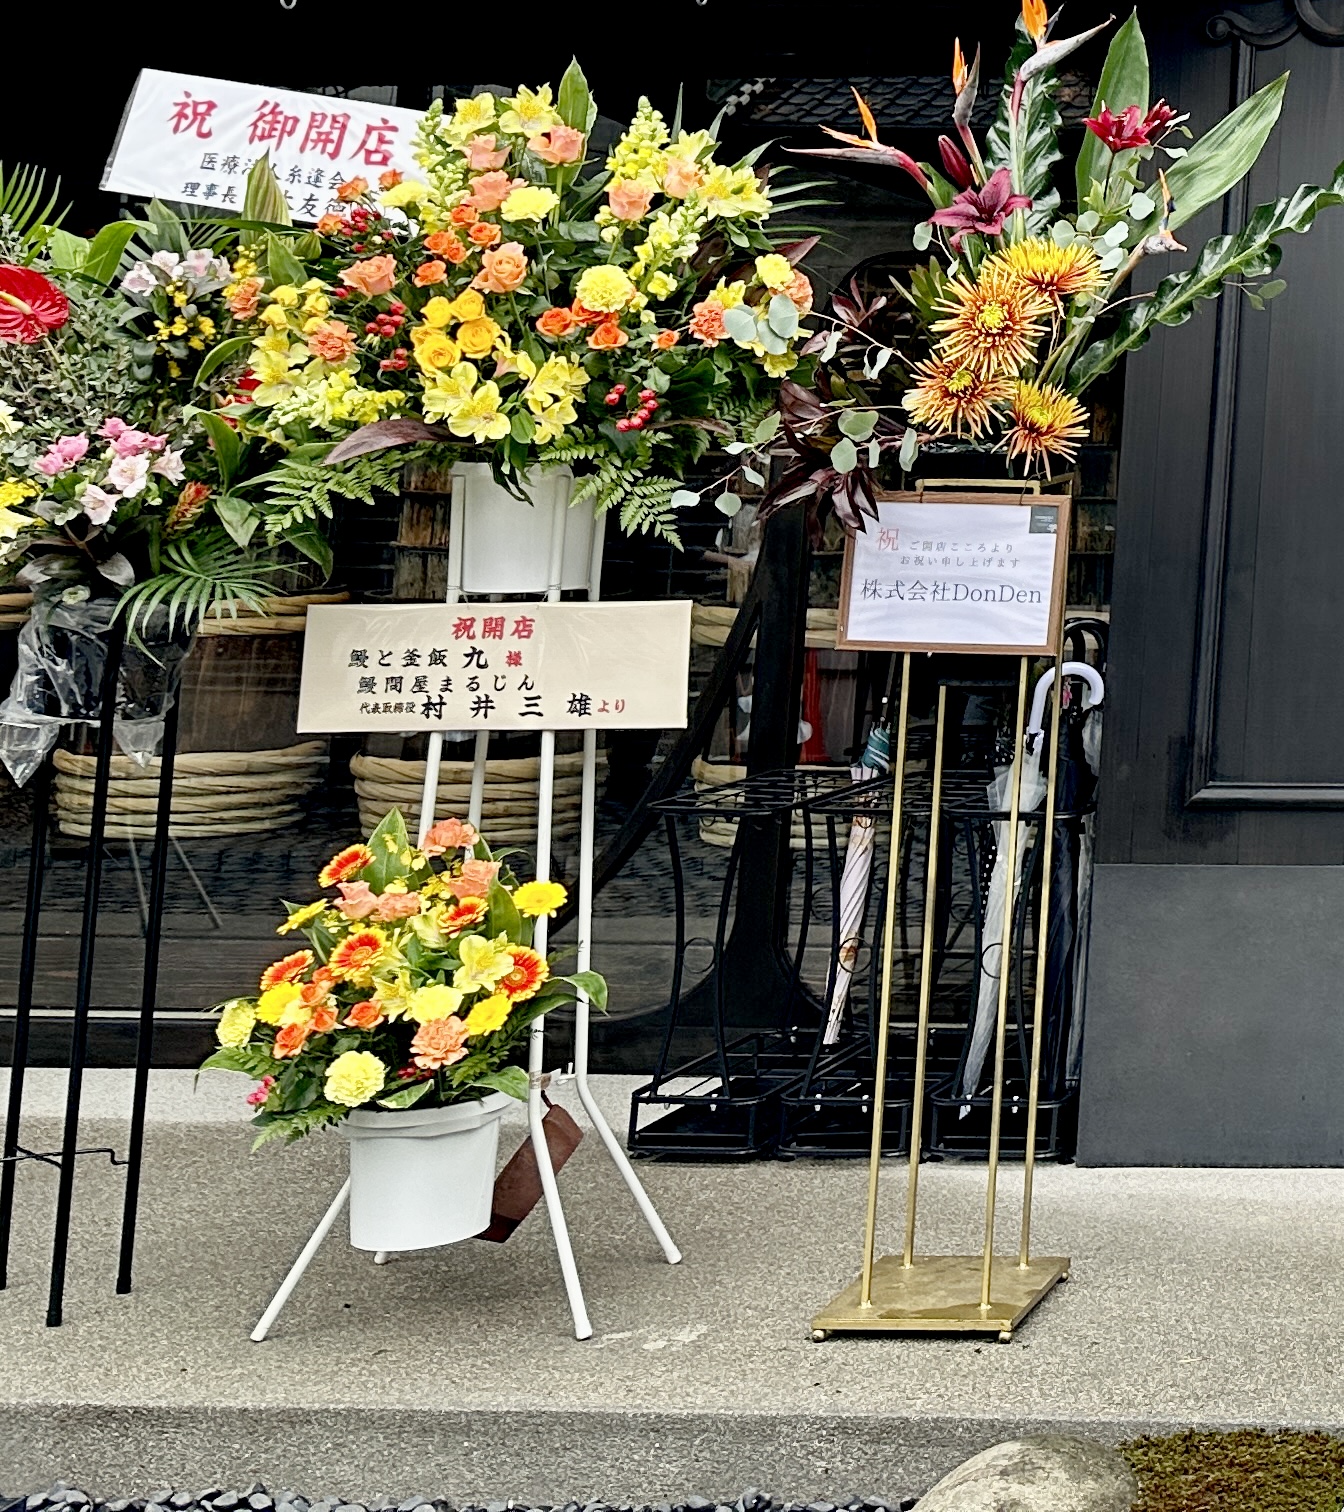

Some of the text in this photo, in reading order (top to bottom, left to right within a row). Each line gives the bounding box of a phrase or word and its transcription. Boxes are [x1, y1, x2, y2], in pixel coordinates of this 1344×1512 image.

[167, 90, 399, 167] 祝 御開店
[181, 182, 237, 204] 理事長
[876, 527, 900, 551] 祝
[909, 540, 1013, 554] ご開店こころより
[900, 555, 1021, 568] お祝い申し上げます
[860, 578, 1043, 604] 株式会社DonDen
[451, 615, 537, 641] 祝開店
[347, 646, 523, 670] 鰻と釜飯 九 様
[356, 674, 536, 695] 鰻問屋まるじん
[359, 692, 626, 720] 代表取締役 村井三雄 より
